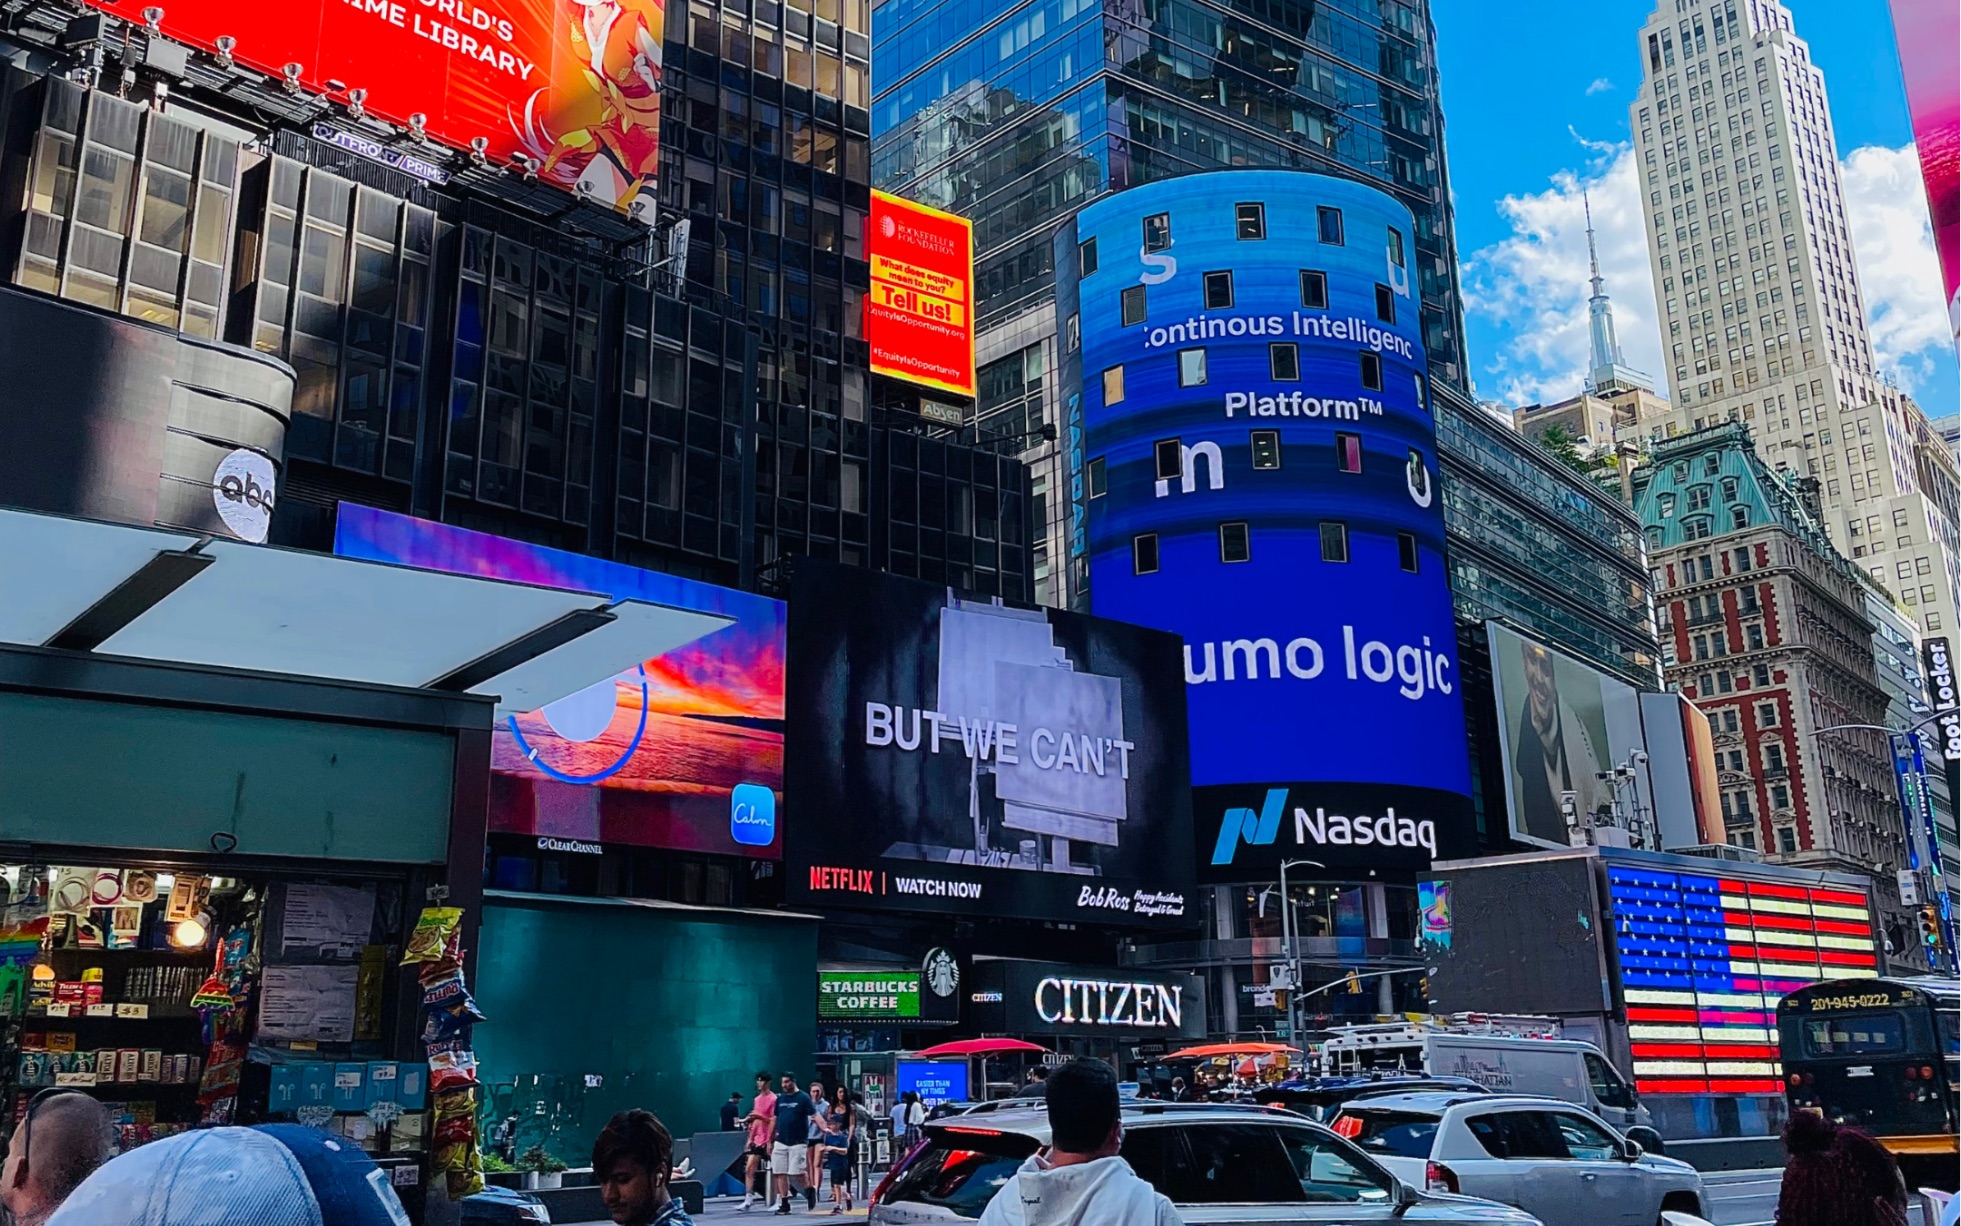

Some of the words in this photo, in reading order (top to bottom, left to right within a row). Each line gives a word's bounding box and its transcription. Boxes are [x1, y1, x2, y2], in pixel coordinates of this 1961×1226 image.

[414, 13, 534, 81] LIBRARY
[317, 125, 399, 163] OUTFRONT
[406, 159, 445, 181] PRIME
[898, 224, 955, 249] ROCKEFELLER
[898, 233, 955, 256] FOUNDATION
[880, 258, 903, 271] What
[904, 264, 926, 279] does
[926, 272, 955, 288] equity
[889, 272, 912, 285] mean
[914, 278, 924, 288] to
[925, 282, 946, 294] you?
[882, 285, 918, 313] Tell
[921, 300, 951, 322] us!
[1144, 314, 1285, 349] ontinous
[873, 347, 961, 379] #EquityIsOpportunity
[923, 403, 960, 421] Absen
[1068, 393, 1086, 558] NASDAQ
[220, 471, 273, 516] abc
[1342, 625, 1453, 701] logic
[866, 701, 948, 754] BUT
[958, 716, 1019, 765] WE
[1030, 727, 1135, 779] CAN'T
[1940, 714, 1961, 760] Foot
[733, 803, 772, 827] Calm
[1294, 807, 1438, 859] Nasdaq
[810, 866, 874, 894] NETFLIX
[895, 877, 946, 896] WATCH
[948, 881, 982, 899] NOW
[1077, 885, 1105, 907] Bob
[1103, 887, 1131, 911] Ross
[1134, 889, 1156, 905] Happy
[821, 980, 918, 993] STARBUCKS
[972, 992, 1003, 1002] CITIZEN
[837, 996, 898, 1009] COFFEE
[1035, 977, 1183, 1028] CITIZEN
[1810, 993, 1890, 1011] 201-945-0222
[916, 1080, 935, 1088] EASIER
[935, 1080, 951, 1088] THAN
